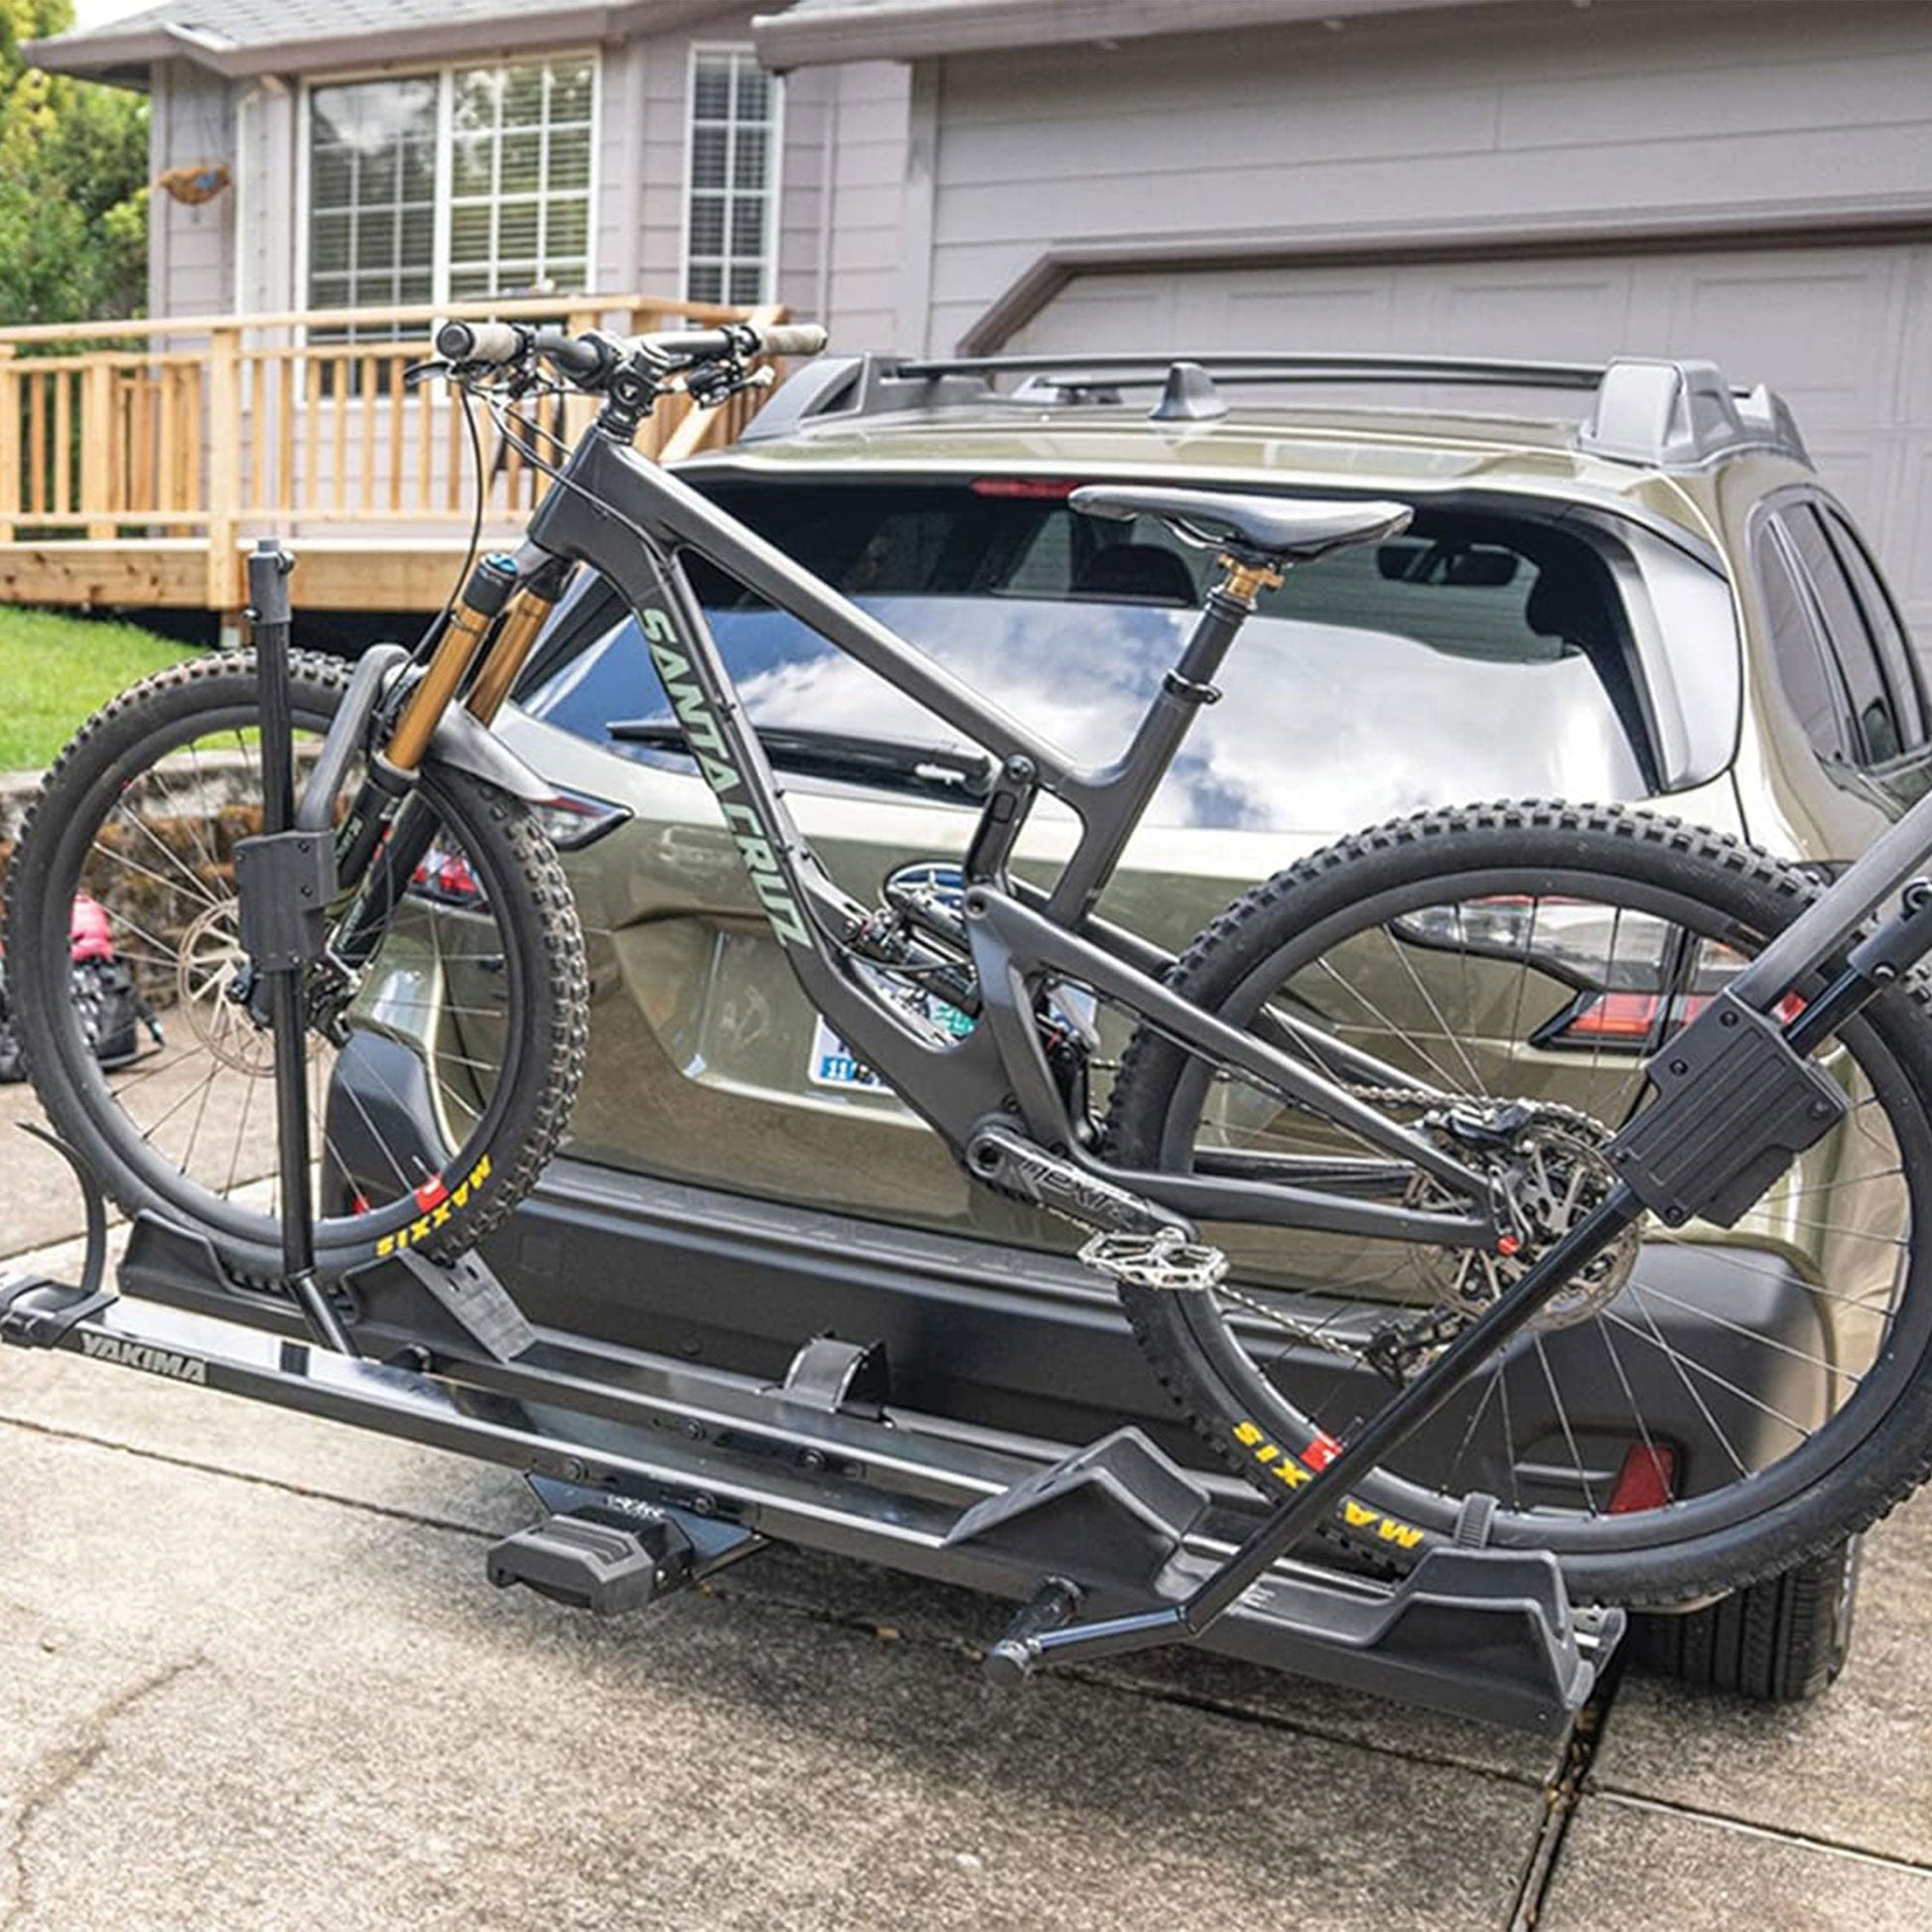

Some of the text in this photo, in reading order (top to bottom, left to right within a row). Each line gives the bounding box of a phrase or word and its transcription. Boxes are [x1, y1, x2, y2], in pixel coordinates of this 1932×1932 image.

[636, 608, 813, 949] SANTA CRUZ
[375, 1154, 492, 1258] MAXXIS
[79, 1333, 207, 1385] YAKIMA
[1232, 1421, 1425, 1550] MAXIS
